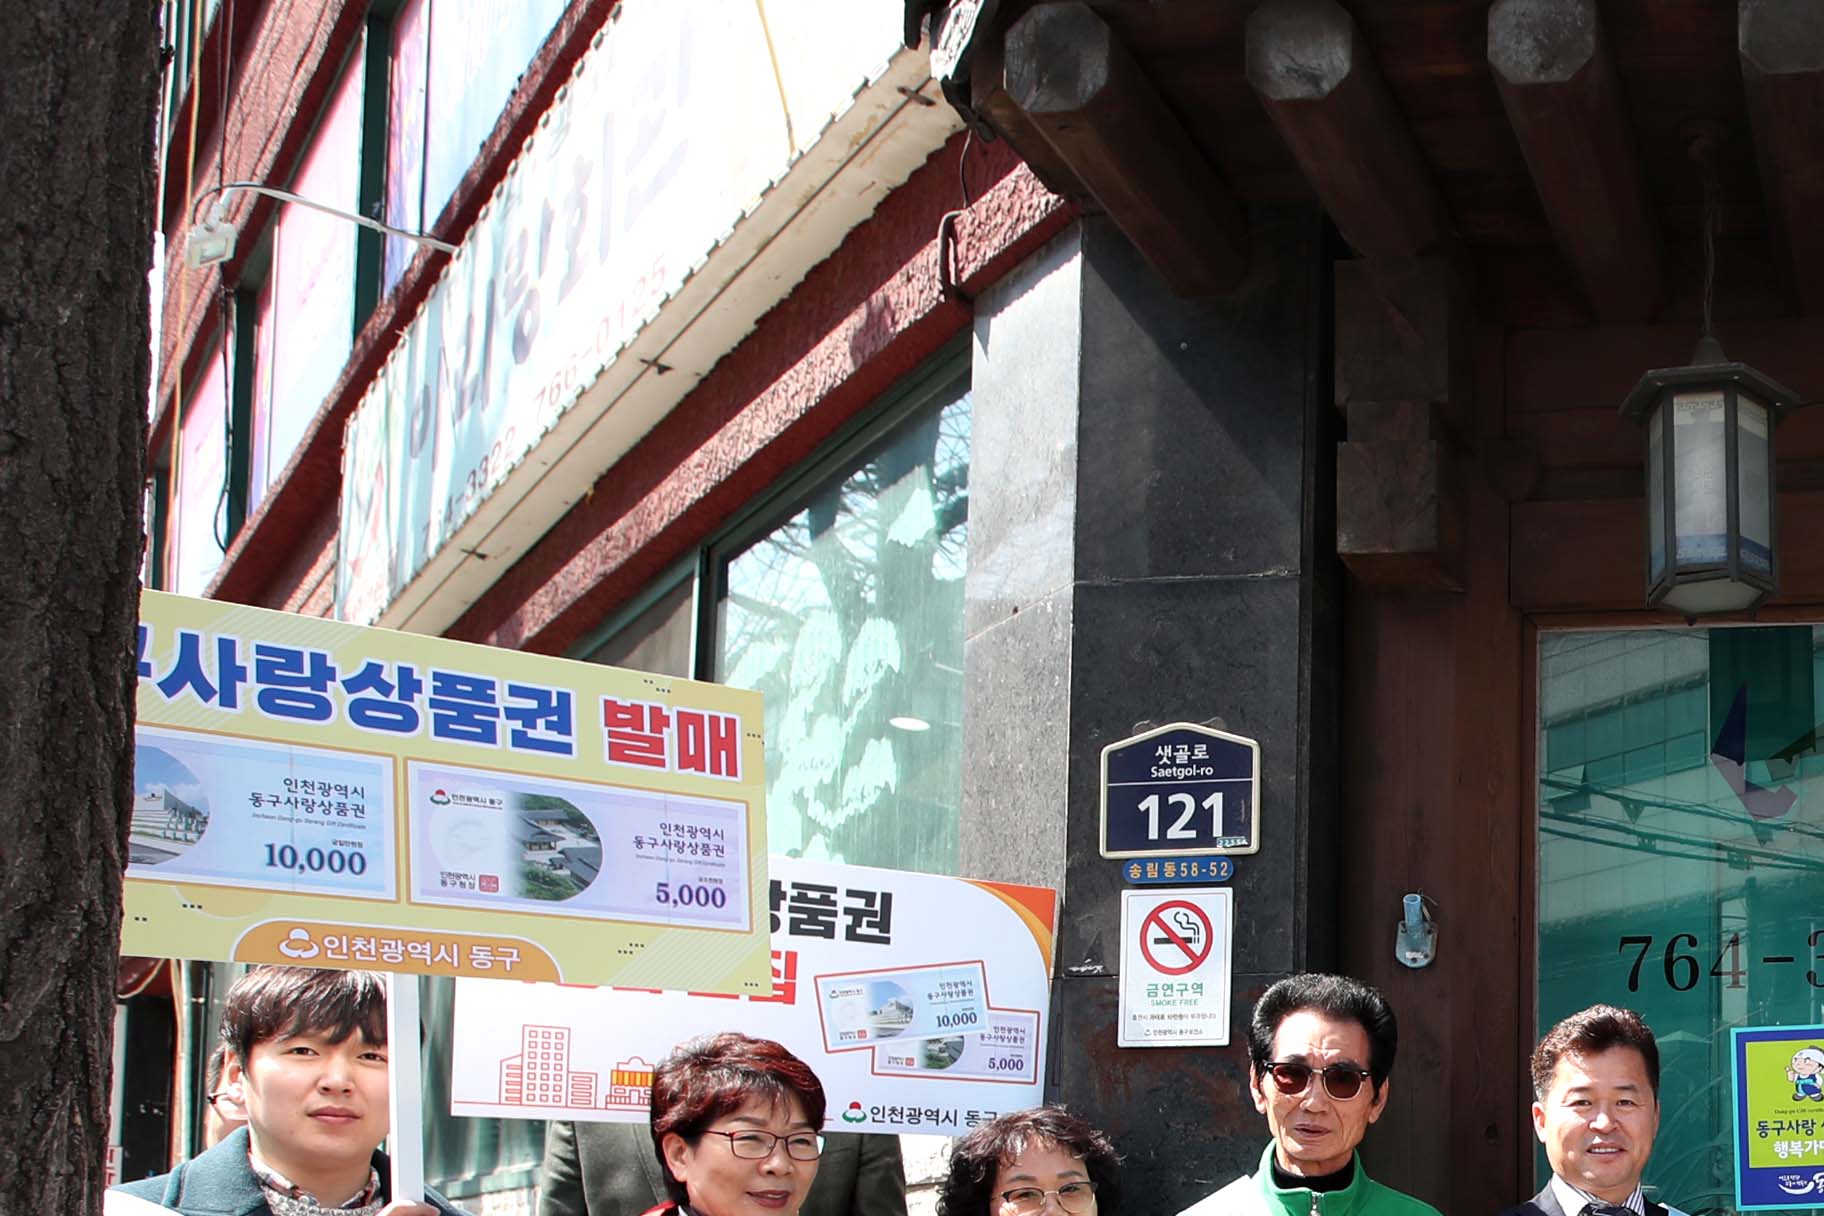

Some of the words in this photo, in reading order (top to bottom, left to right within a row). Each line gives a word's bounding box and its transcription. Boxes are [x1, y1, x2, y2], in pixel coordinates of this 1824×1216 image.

[602, 699, 740, 780] 발매
[1155, 743, 1210, 765] 샛골로
[1150, 764, 1214, 781] Saetgol-ro
[283, 777, 365, 799] 인천광역시
[248, 792, 366, 819] 동구사랑상품권
[1137, 792, 1224, 841] 121
[659, 822, 725, 841] 인천광역시
[633, 835, 725, 858] 동구사랑상품권
[264, 842, 367, 875] 10,000
[656, 882, 726, 909] 5,000
[323, 934, 459, 970] 인천광역시
[468, 943, 522, 972] 동구
[1146, 982, 1204, 998] 금연구역
[1150, 999, 1177, 1007] SMOKE
[936, 1011, 978, 1028] 10,000
[988, 1057, 1025, 1071] 5,000
[870, 1105, 958, 1127] 인천광역시
[1756, 1118, 1816, 1138] 동구사랑
